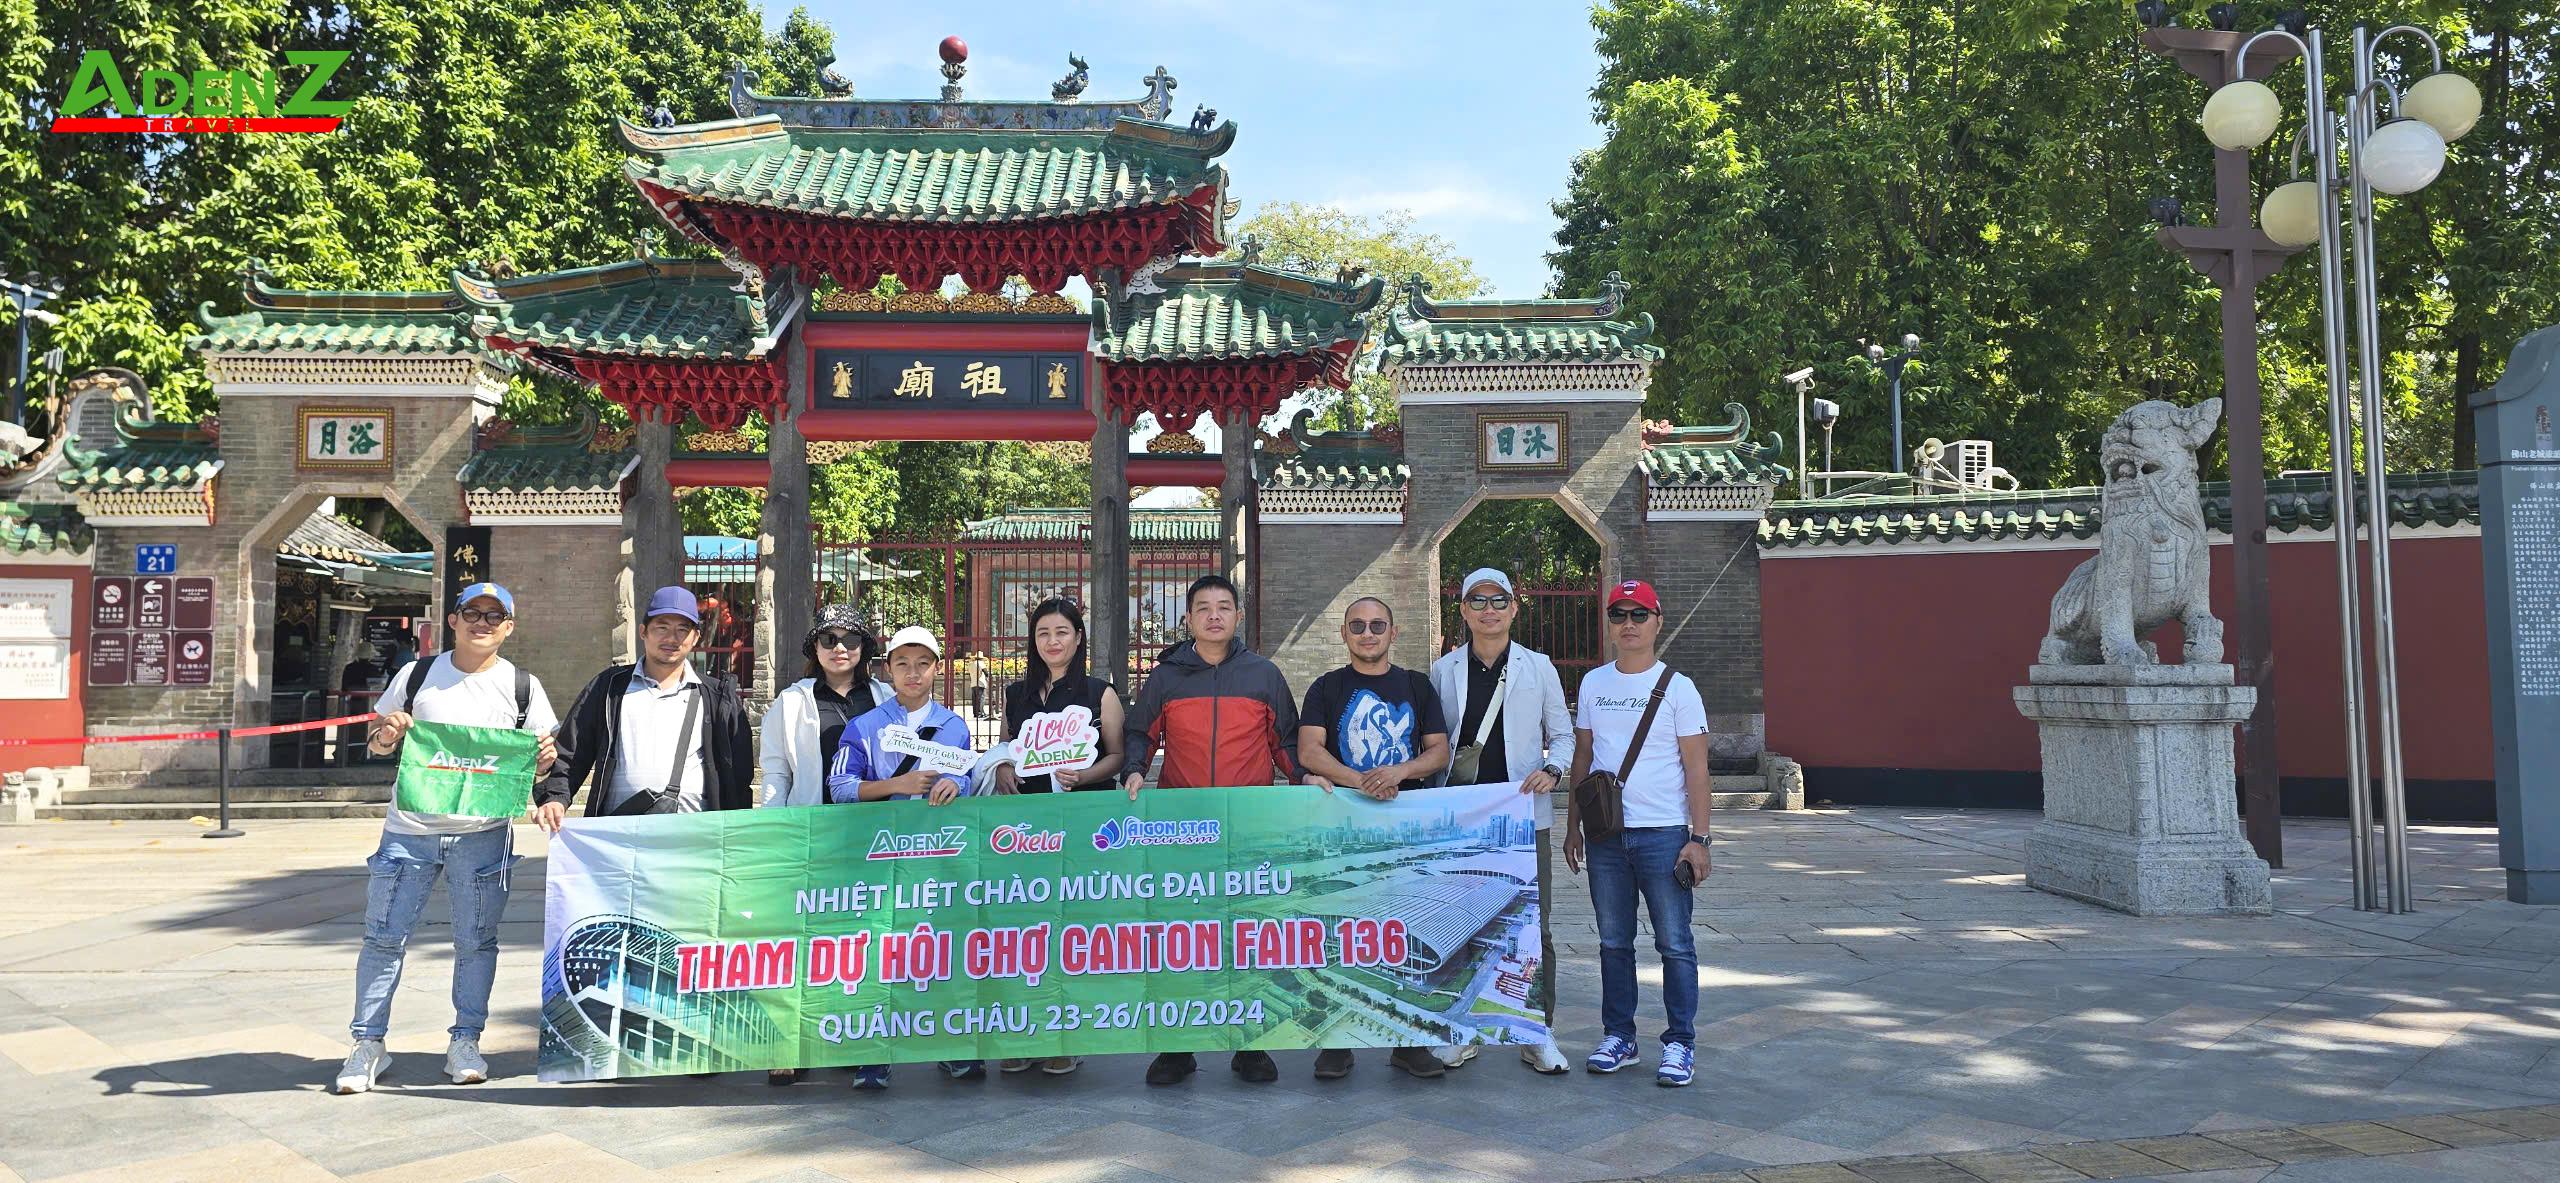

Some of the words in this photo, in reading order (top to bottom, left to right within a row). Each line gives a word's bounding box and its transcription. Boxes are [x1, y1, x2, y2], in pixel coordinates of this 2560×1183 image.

[147, 556, 166, 571] 21
[1129, 836, 1219, 846] Tourism
[1179, 820, 1220, 836] STAR
[795, 881, 889, 918] NHIỆT
[895, 878, 958, 916] LIỆT
[964, 873, 1051, 905] CHÀO
[1059, 870, 1155, 901] MỪNG
[1162, 873, 1217, 904] ĐẠI
[1224, 861, 1293, 896] BIỂU
[676, 938, 798, 994] THAM
[807, 930, 872, 995] DỰ
[879, 922, 953, 992] HỘI
[964, 922, 1051, 987] CHỢ
[1060, 920, 1223, 976] CANTON
[1233, 918, 1327, 971] FAIR
[1335, 917, 1409, 969] 136
[818, 1005, 936, 1044] QUẢNG
[943, 1002, 1036, 1036] CHÂU,
[1045, 999, 1265, 1031] 23-26/10/2024
